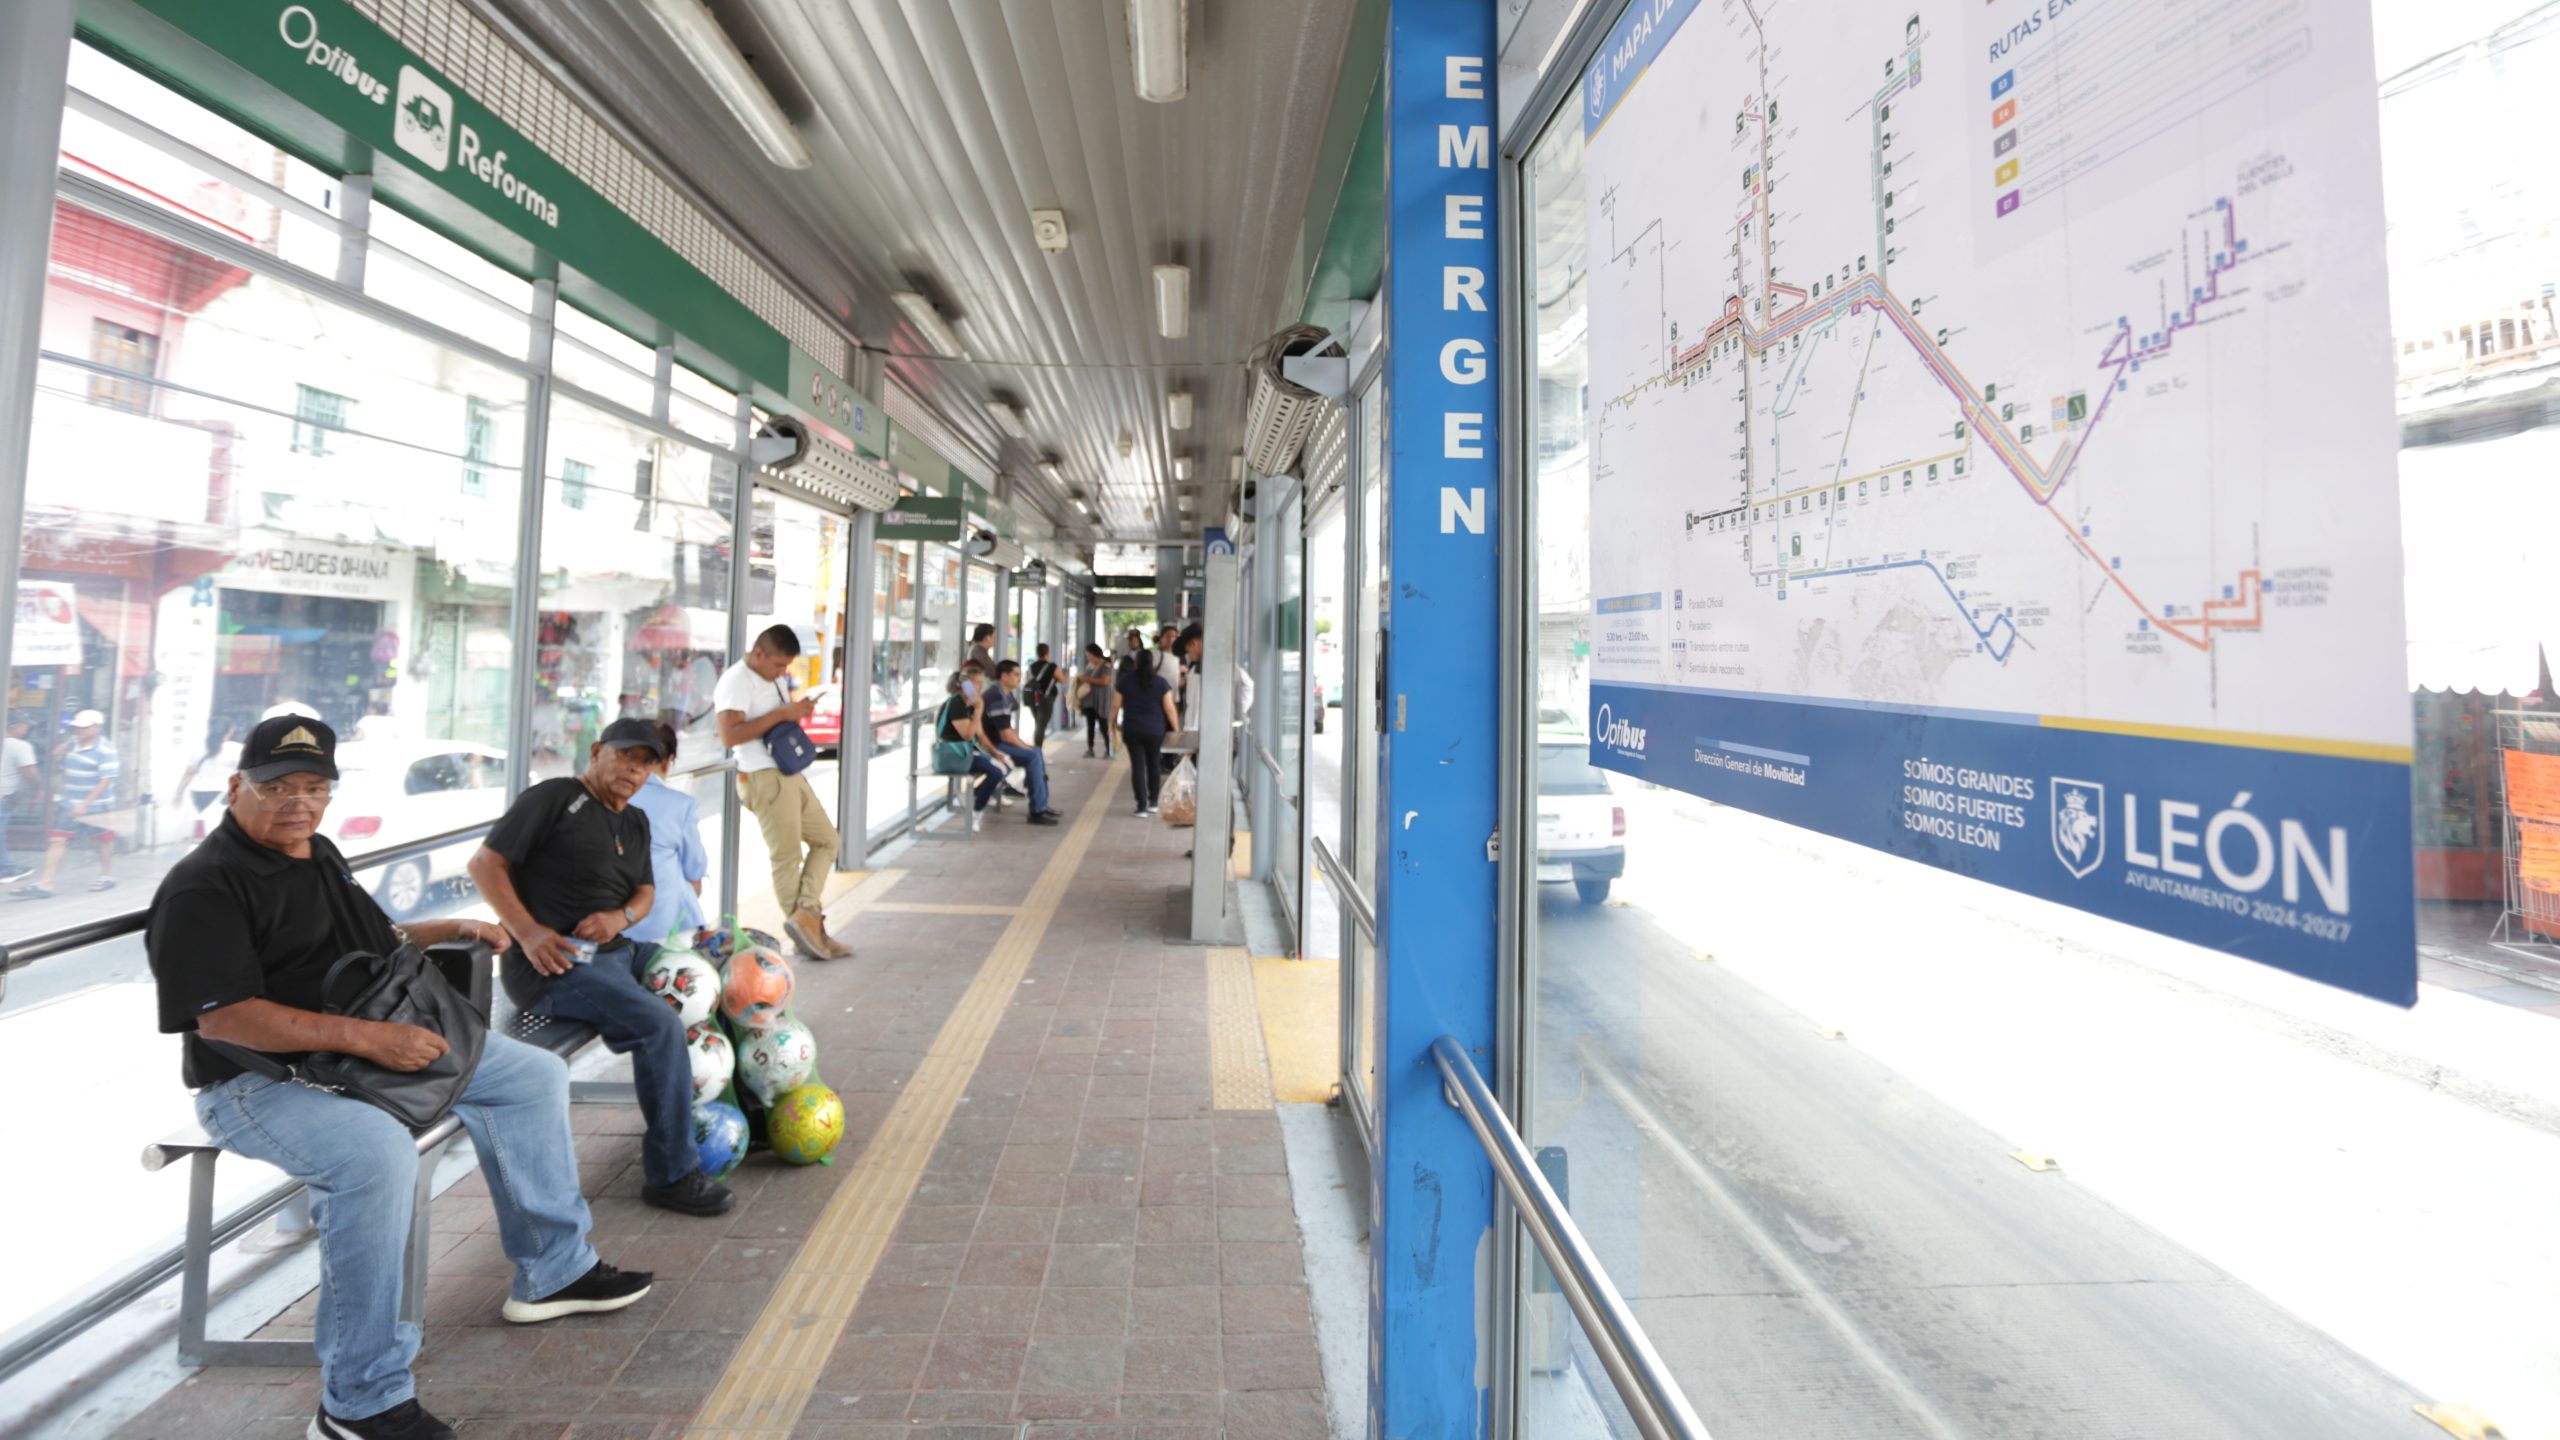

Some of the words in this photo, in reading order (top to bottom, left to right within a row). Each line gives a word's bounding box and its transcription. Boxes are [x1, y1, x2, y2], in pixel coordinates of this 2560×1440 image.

[279, 5, 391, 106] Optibus
[1612, 10, 1652, 82] MAPA
[1989, 8, 2043, 64] RUTAS
[457, 123, 560, 229] Reforma
[1438, 56, 1490, 535] EMERGEN
[236, 548, 338, 577] VEDADES
[1689, 663, 1709, 674] Sentido
[1718, 665, 1745, 676] recorrido
[1596, 703, 1647, 752] Optibus
[1694, 748, 1724, 770] Dirección
[1725, 756, 1752, 775] General
[1753, 760, 1763, 776] de
[1763, 762, 1806, 787] Movilidad
[1904, 758, 1955, 786] SOMOS
[1956, 767, 2035, 801] GRANDES
[1904, 785, 1955, 814] SOMOS
[1957, 795, 2026, 829] FUERTES
[1904, 810, 1955, 840] SOMOS
[1957, 822, 2001, 852] LEÓN
[2123, 790, 2351, 916] LEÓN
[2124, 868, 2250, 917] AYUNTAMIENTO
[2251, 900, 2353, 944] 2024-2027
[752, 1048, 769, 1067] 5
